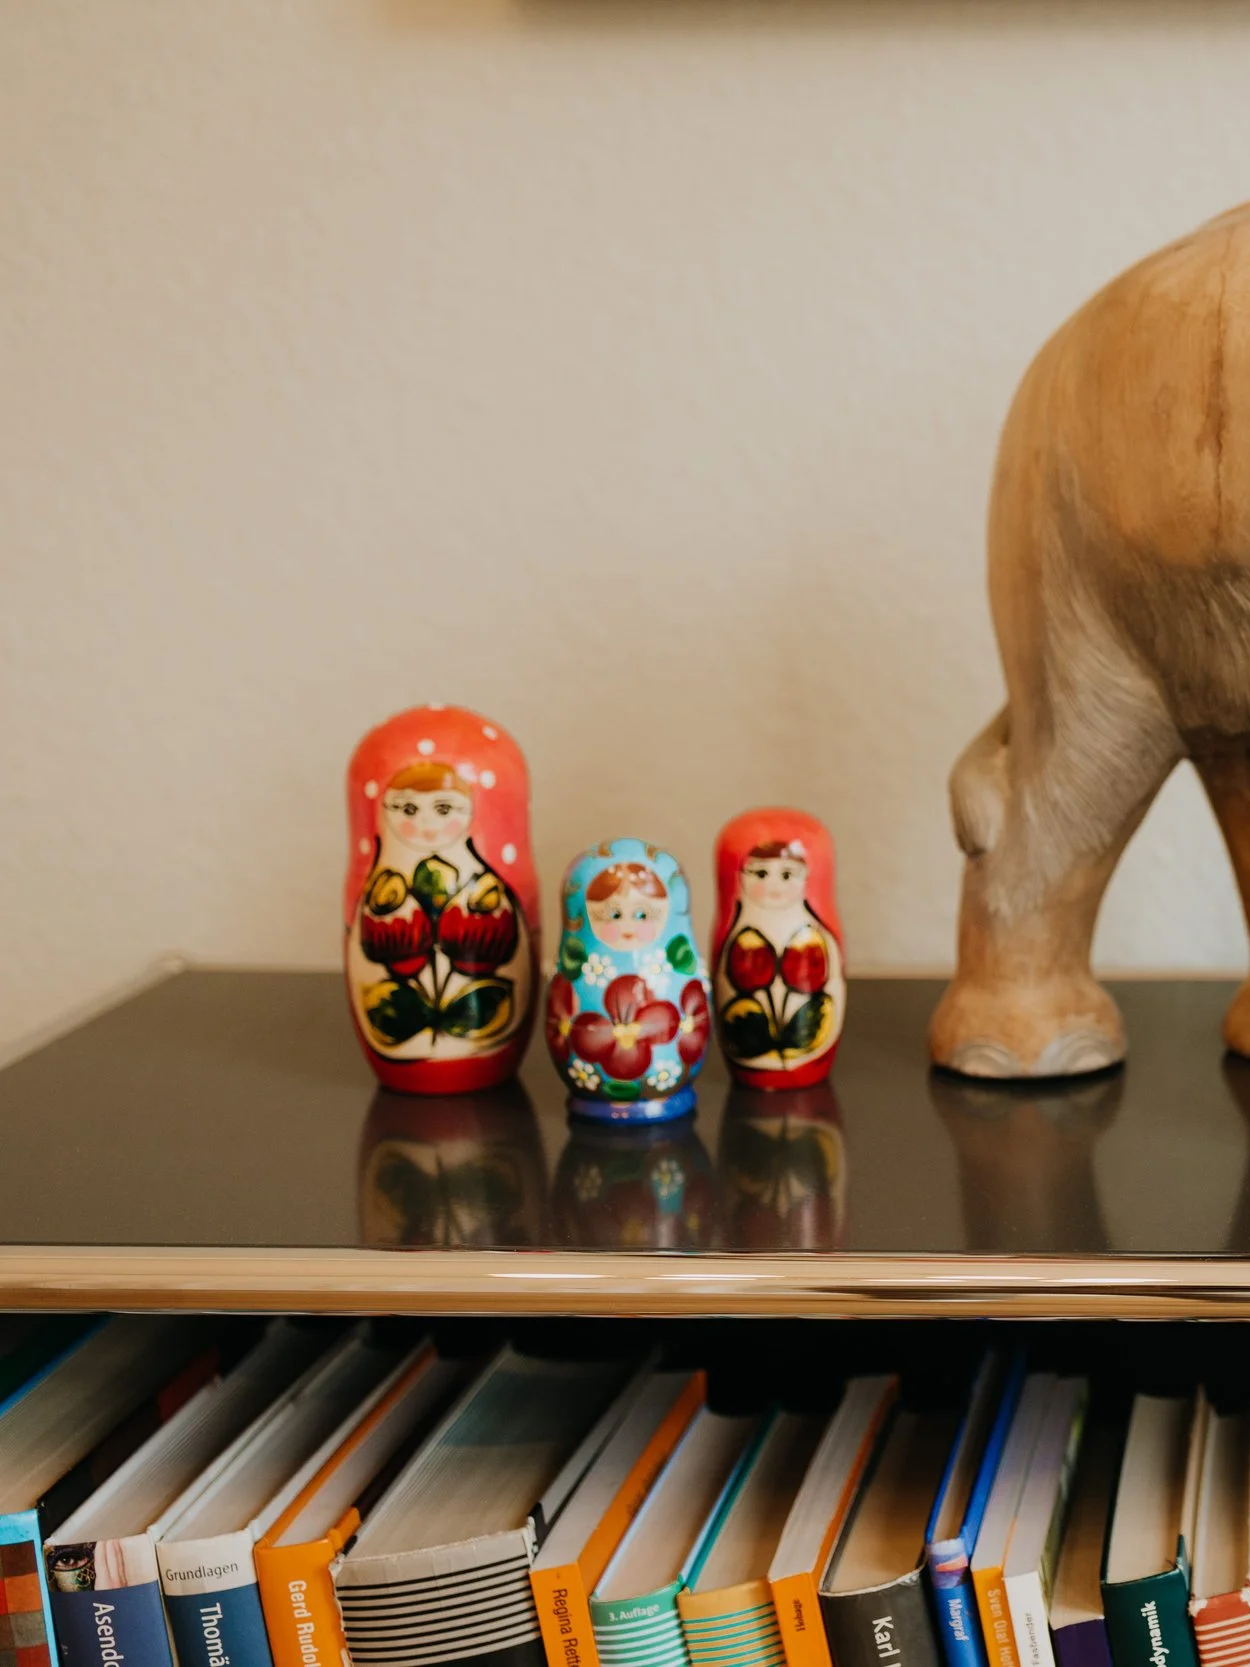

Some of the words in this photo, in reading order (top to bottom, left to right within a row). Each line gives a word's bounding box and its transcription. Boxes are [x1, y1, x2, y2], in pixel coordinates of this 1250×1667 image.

[165, 1562, 239, 1581] Grundlagen
[288, 1580, 312, 1618] Gerd
[552, 1588, 573, 1635] Regina
[609, 1612, 619, 1622] 3.
[620, 1604, 660, 1620] Auflage
[987, 1588, 1003, 1618] Sven
[200, 1602, 230, 1667] Thomä
[871, 1615, 901, 1658] Karl
[947, 1598, 970, 1641] Margraf
[993, 1619, 1009, 1644] Olaf
[1140, 1600, 1170, 1667] dynamik
[562, 1638, 581, 1667] Rett
